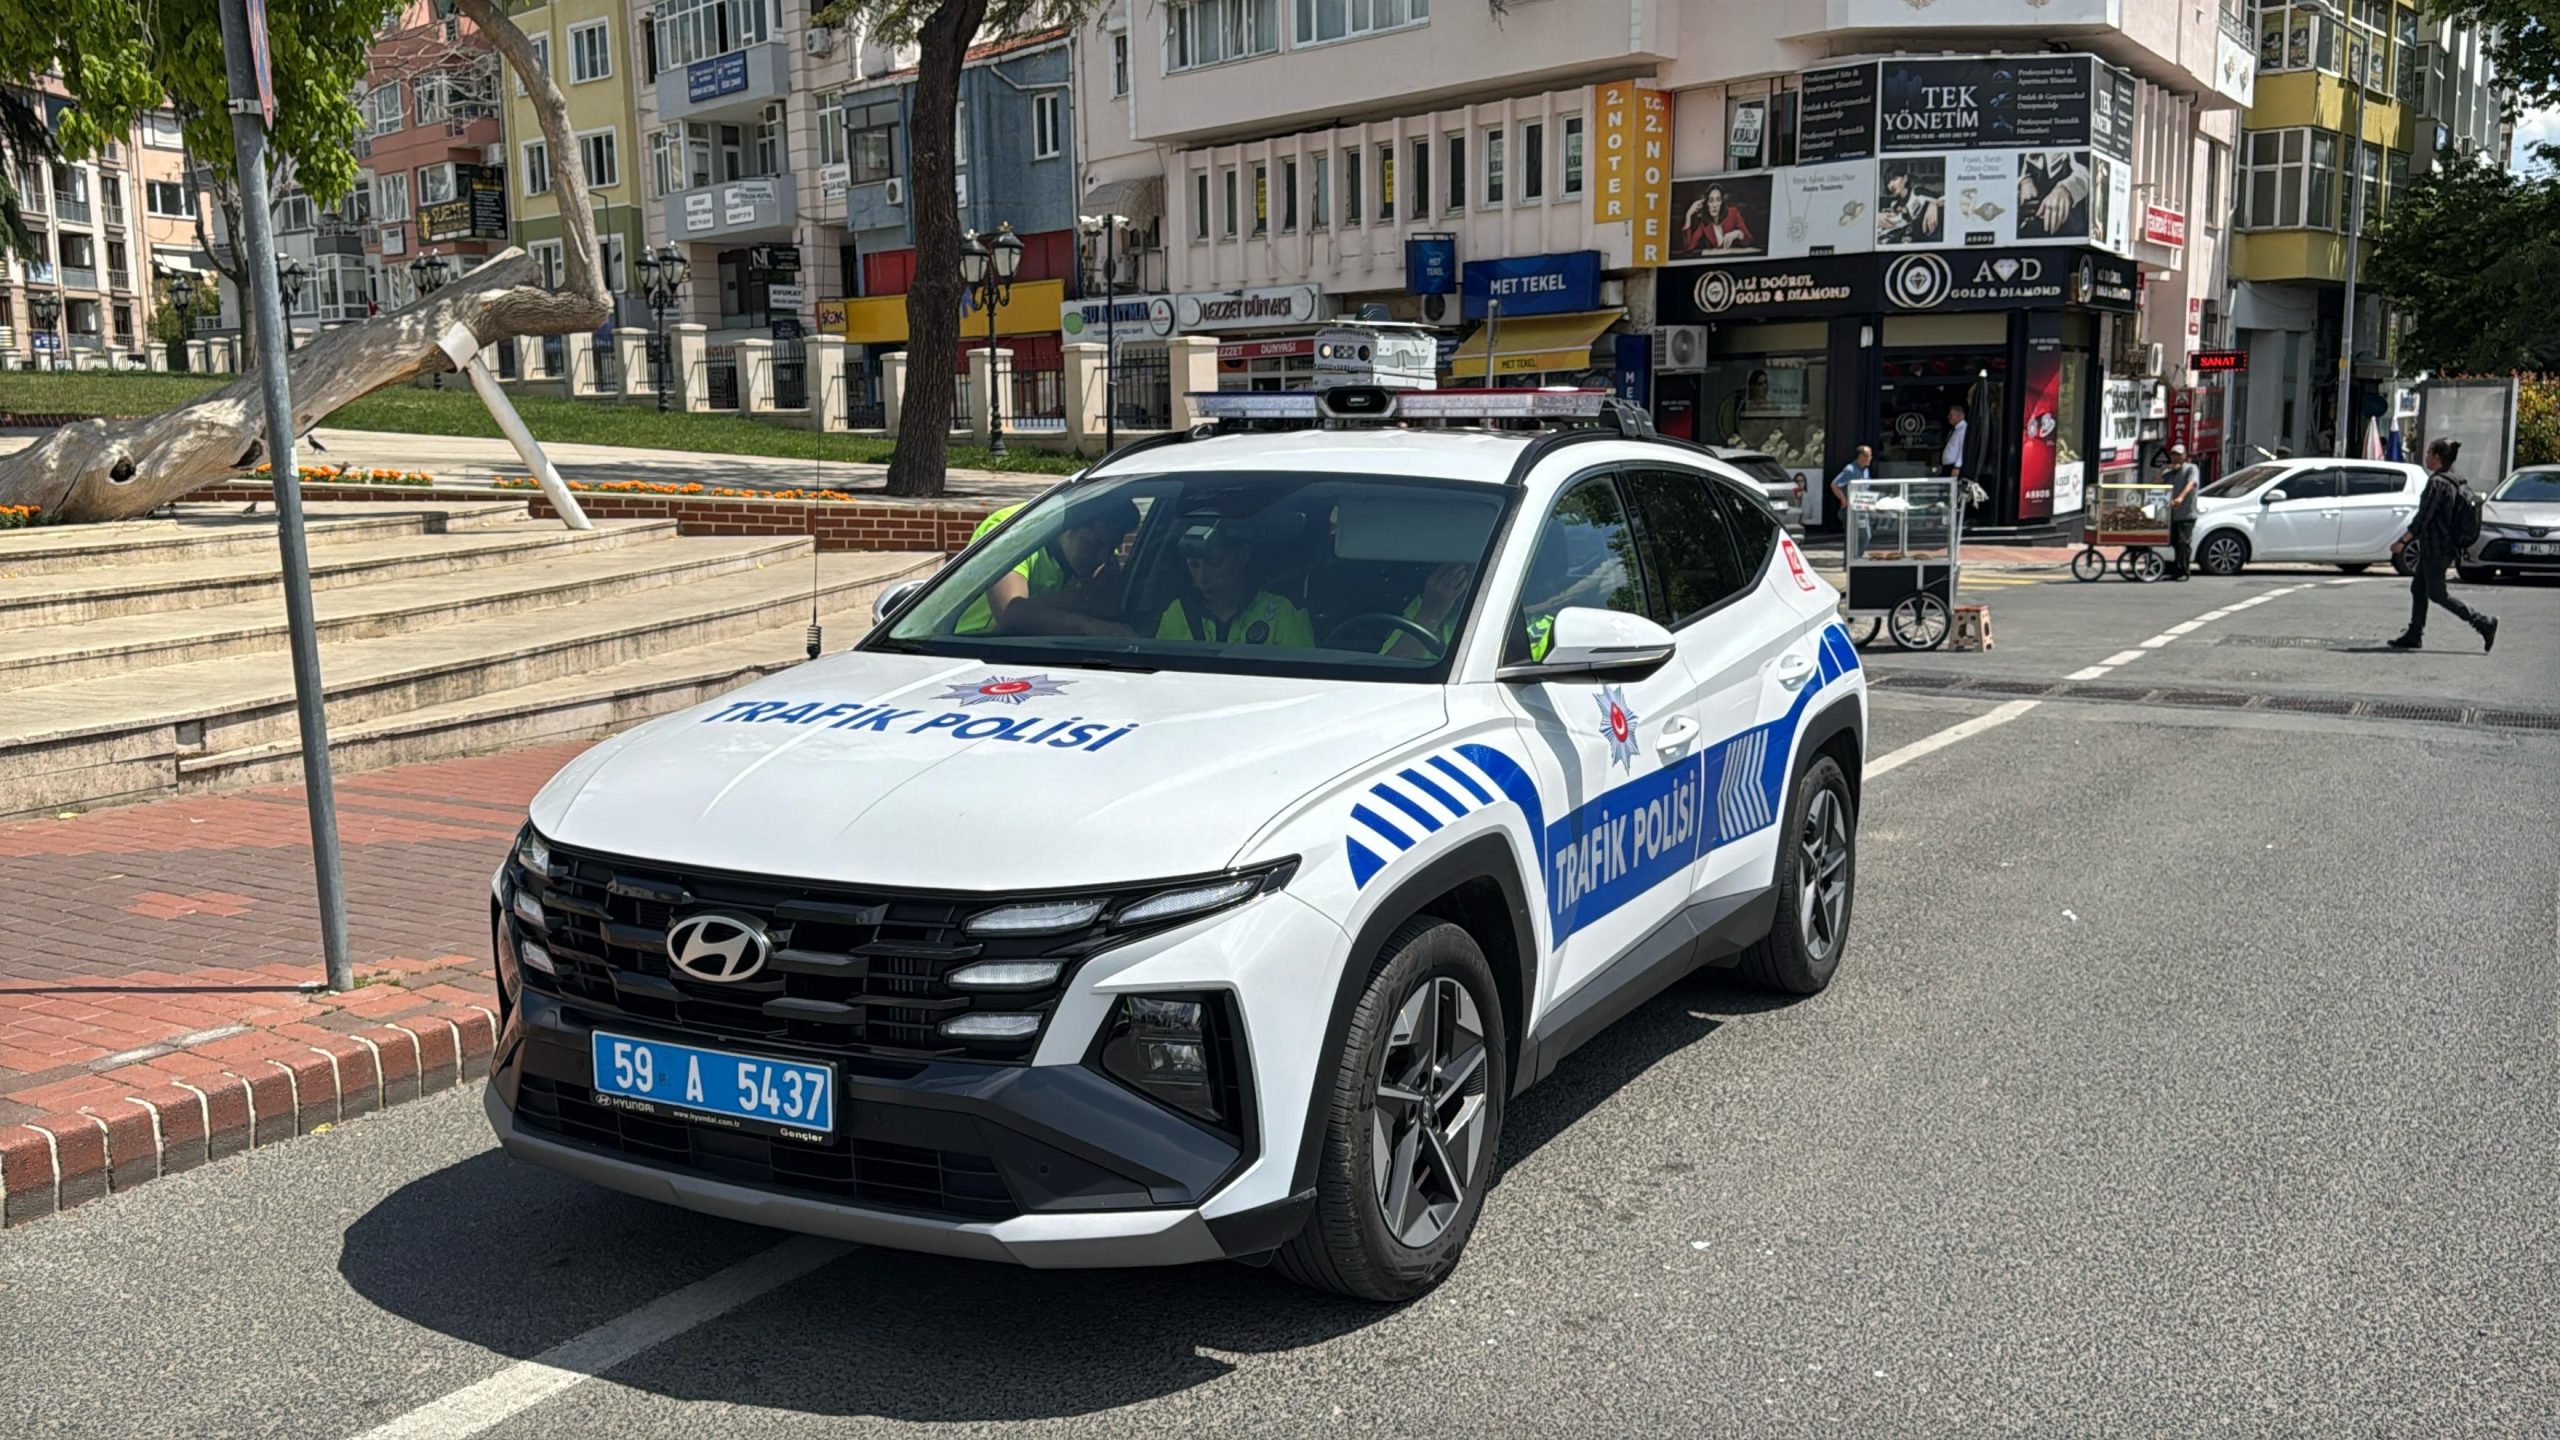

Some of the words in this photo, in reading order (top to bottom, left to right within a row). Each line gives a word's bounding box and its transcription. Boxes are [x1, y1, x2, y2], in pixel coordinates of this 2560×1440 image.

[1606, 89, 1624, 106] 2.
[1643, 96, 1665, 111] T.C.
[1921, 85, 1979, 109] TEK
[1644, 115, 1663, 133] 2.
[1884, 107, 1979, 131] YÖNETİM
[1607, 111, 1623, 217] NOTER
[1643, 140, 1661, 262] NOTER
[1490, 276, 1517, 296] MET
[1521, 273, 1568, 294] TEKEL
[1951, 285, 1986, 299] GOLD
[1988, 285, 1998, 298] &
[1999, 284, 2062, 298] DIAMOND
[1218, 345, 1244, 357] EZZET
[2200, 356, 2237, 368] SANAT
[2024, 488, 2051, 500] ASSOS
[701, 701, 918, 733] TRAFİK
[905, 711, 1141, 753] POLİSİ
[1555, 808, 1628, 916] TRAFİK
[1633, 769, 1695, 868] POLİSİ
[614, 1042, 654, 1093] 59
[685, 1054, 704, 1104] A
[737, 1062, 825, 1121] 5437
[612, 1097, 655, 1114] HYUNDAI
[779, 1126, 824, 1143] Gençler
